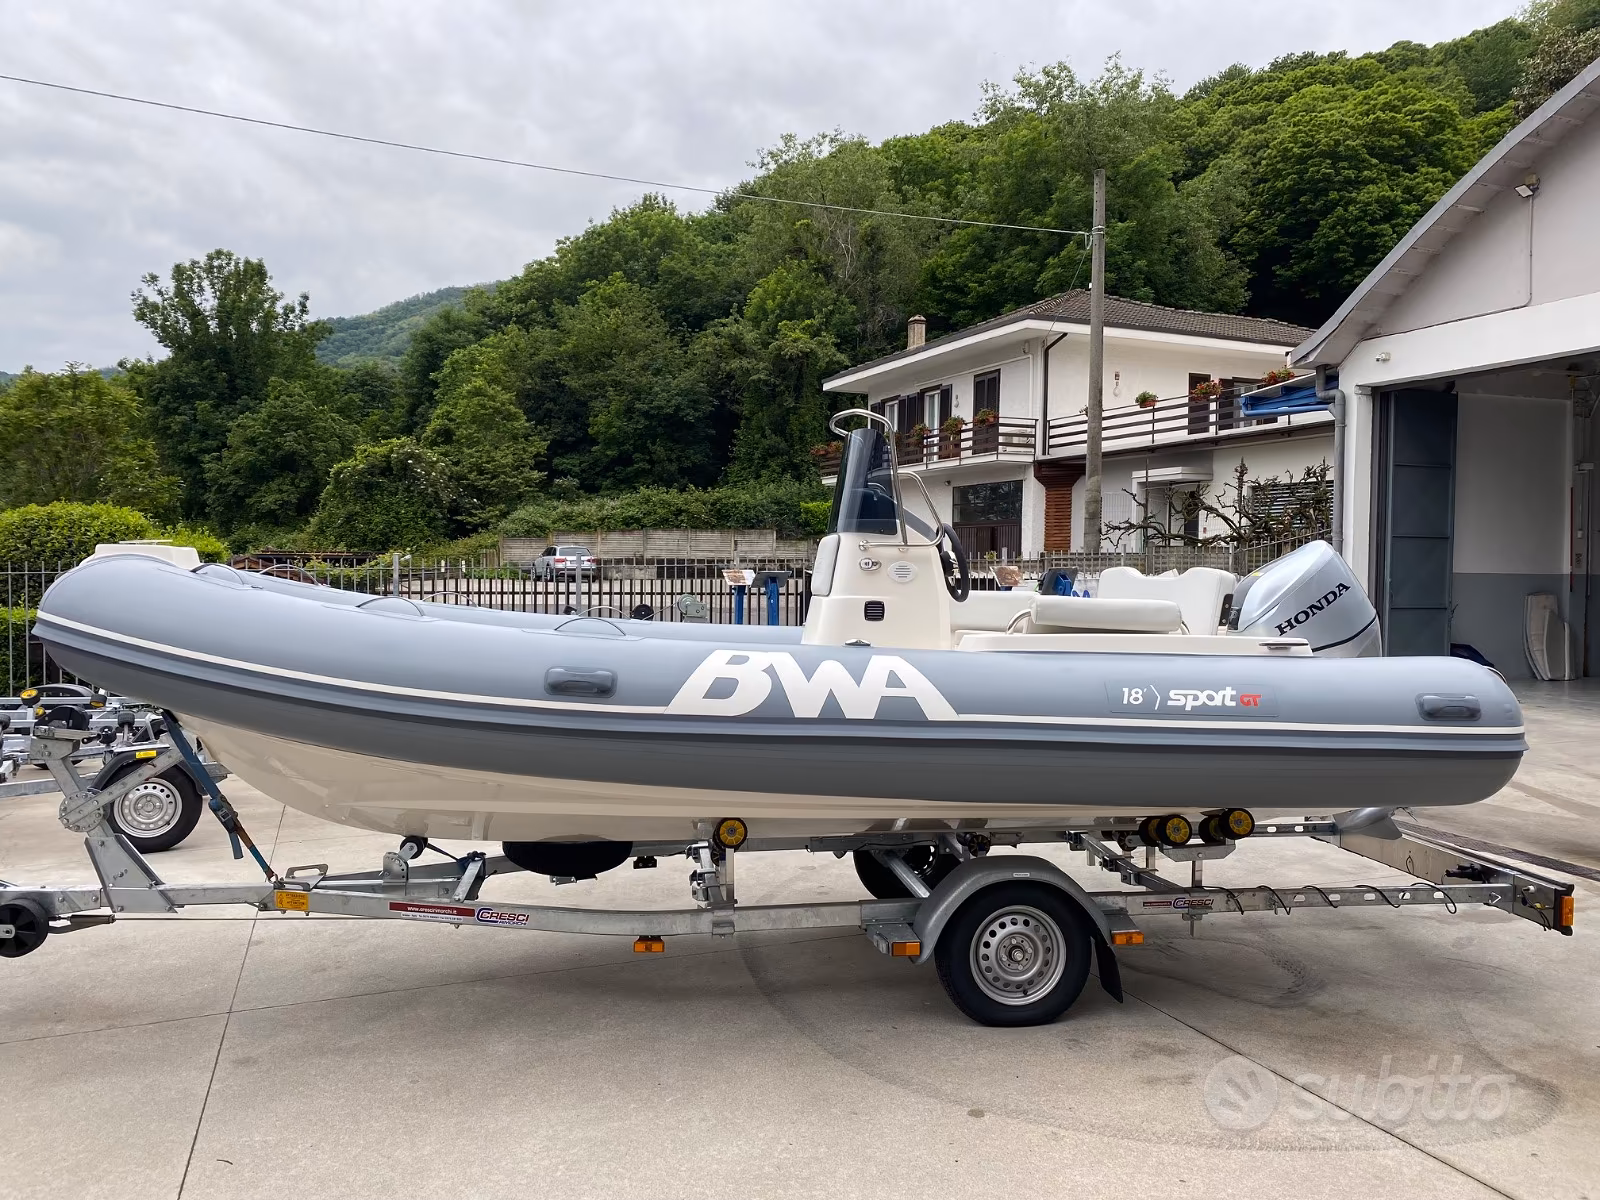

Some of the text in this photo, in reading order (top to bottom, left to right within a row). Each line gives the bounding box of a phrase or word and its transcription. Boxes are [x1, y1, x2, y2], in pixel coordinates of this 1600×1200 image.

[1274, 582, 1351, 637] HONDA
[663, 649, 960, 721] BWA
[1167, 686, 1237, 711] sport
[1240, 693, 1262, 707] GT
[476, 907, 530, 923] CRESCI
[1173, 897, 1215, 909] CRESCI
